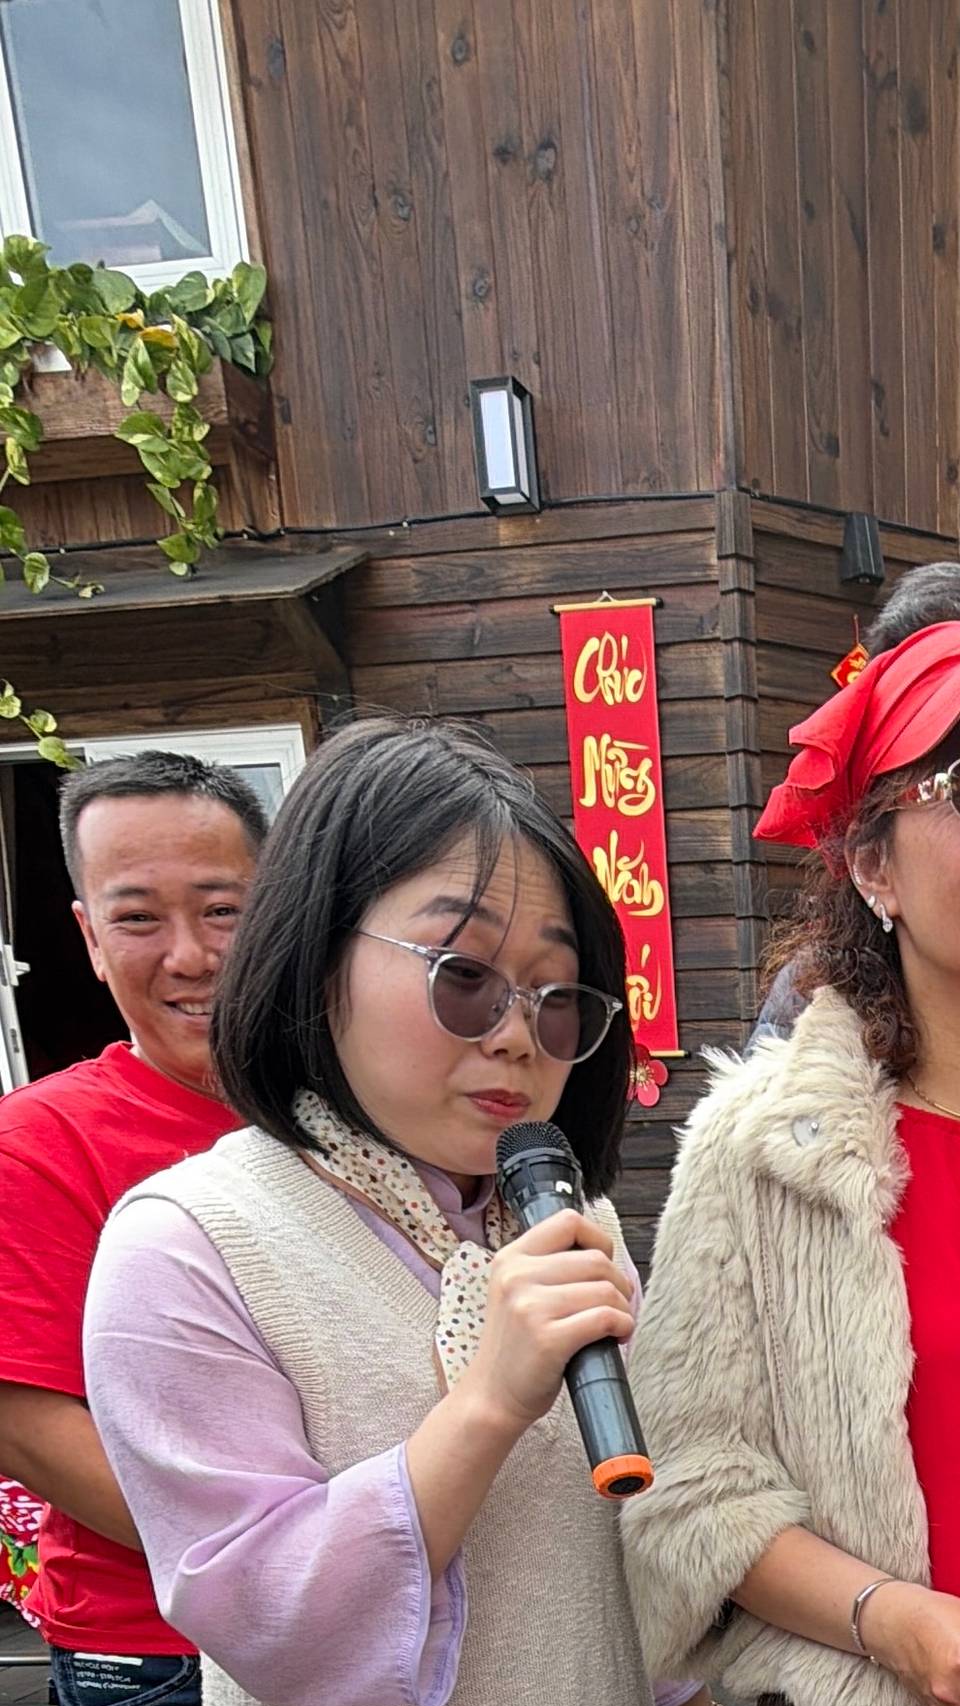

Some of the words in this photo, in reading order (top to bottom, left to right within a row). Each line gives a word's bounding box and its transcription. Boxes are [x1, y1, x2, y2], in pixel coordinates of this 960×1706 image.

[574, 631, 647, 705] Chúc
[579, 733, 655, 816] Mừng
[626, 943, 662, 1033] ới
